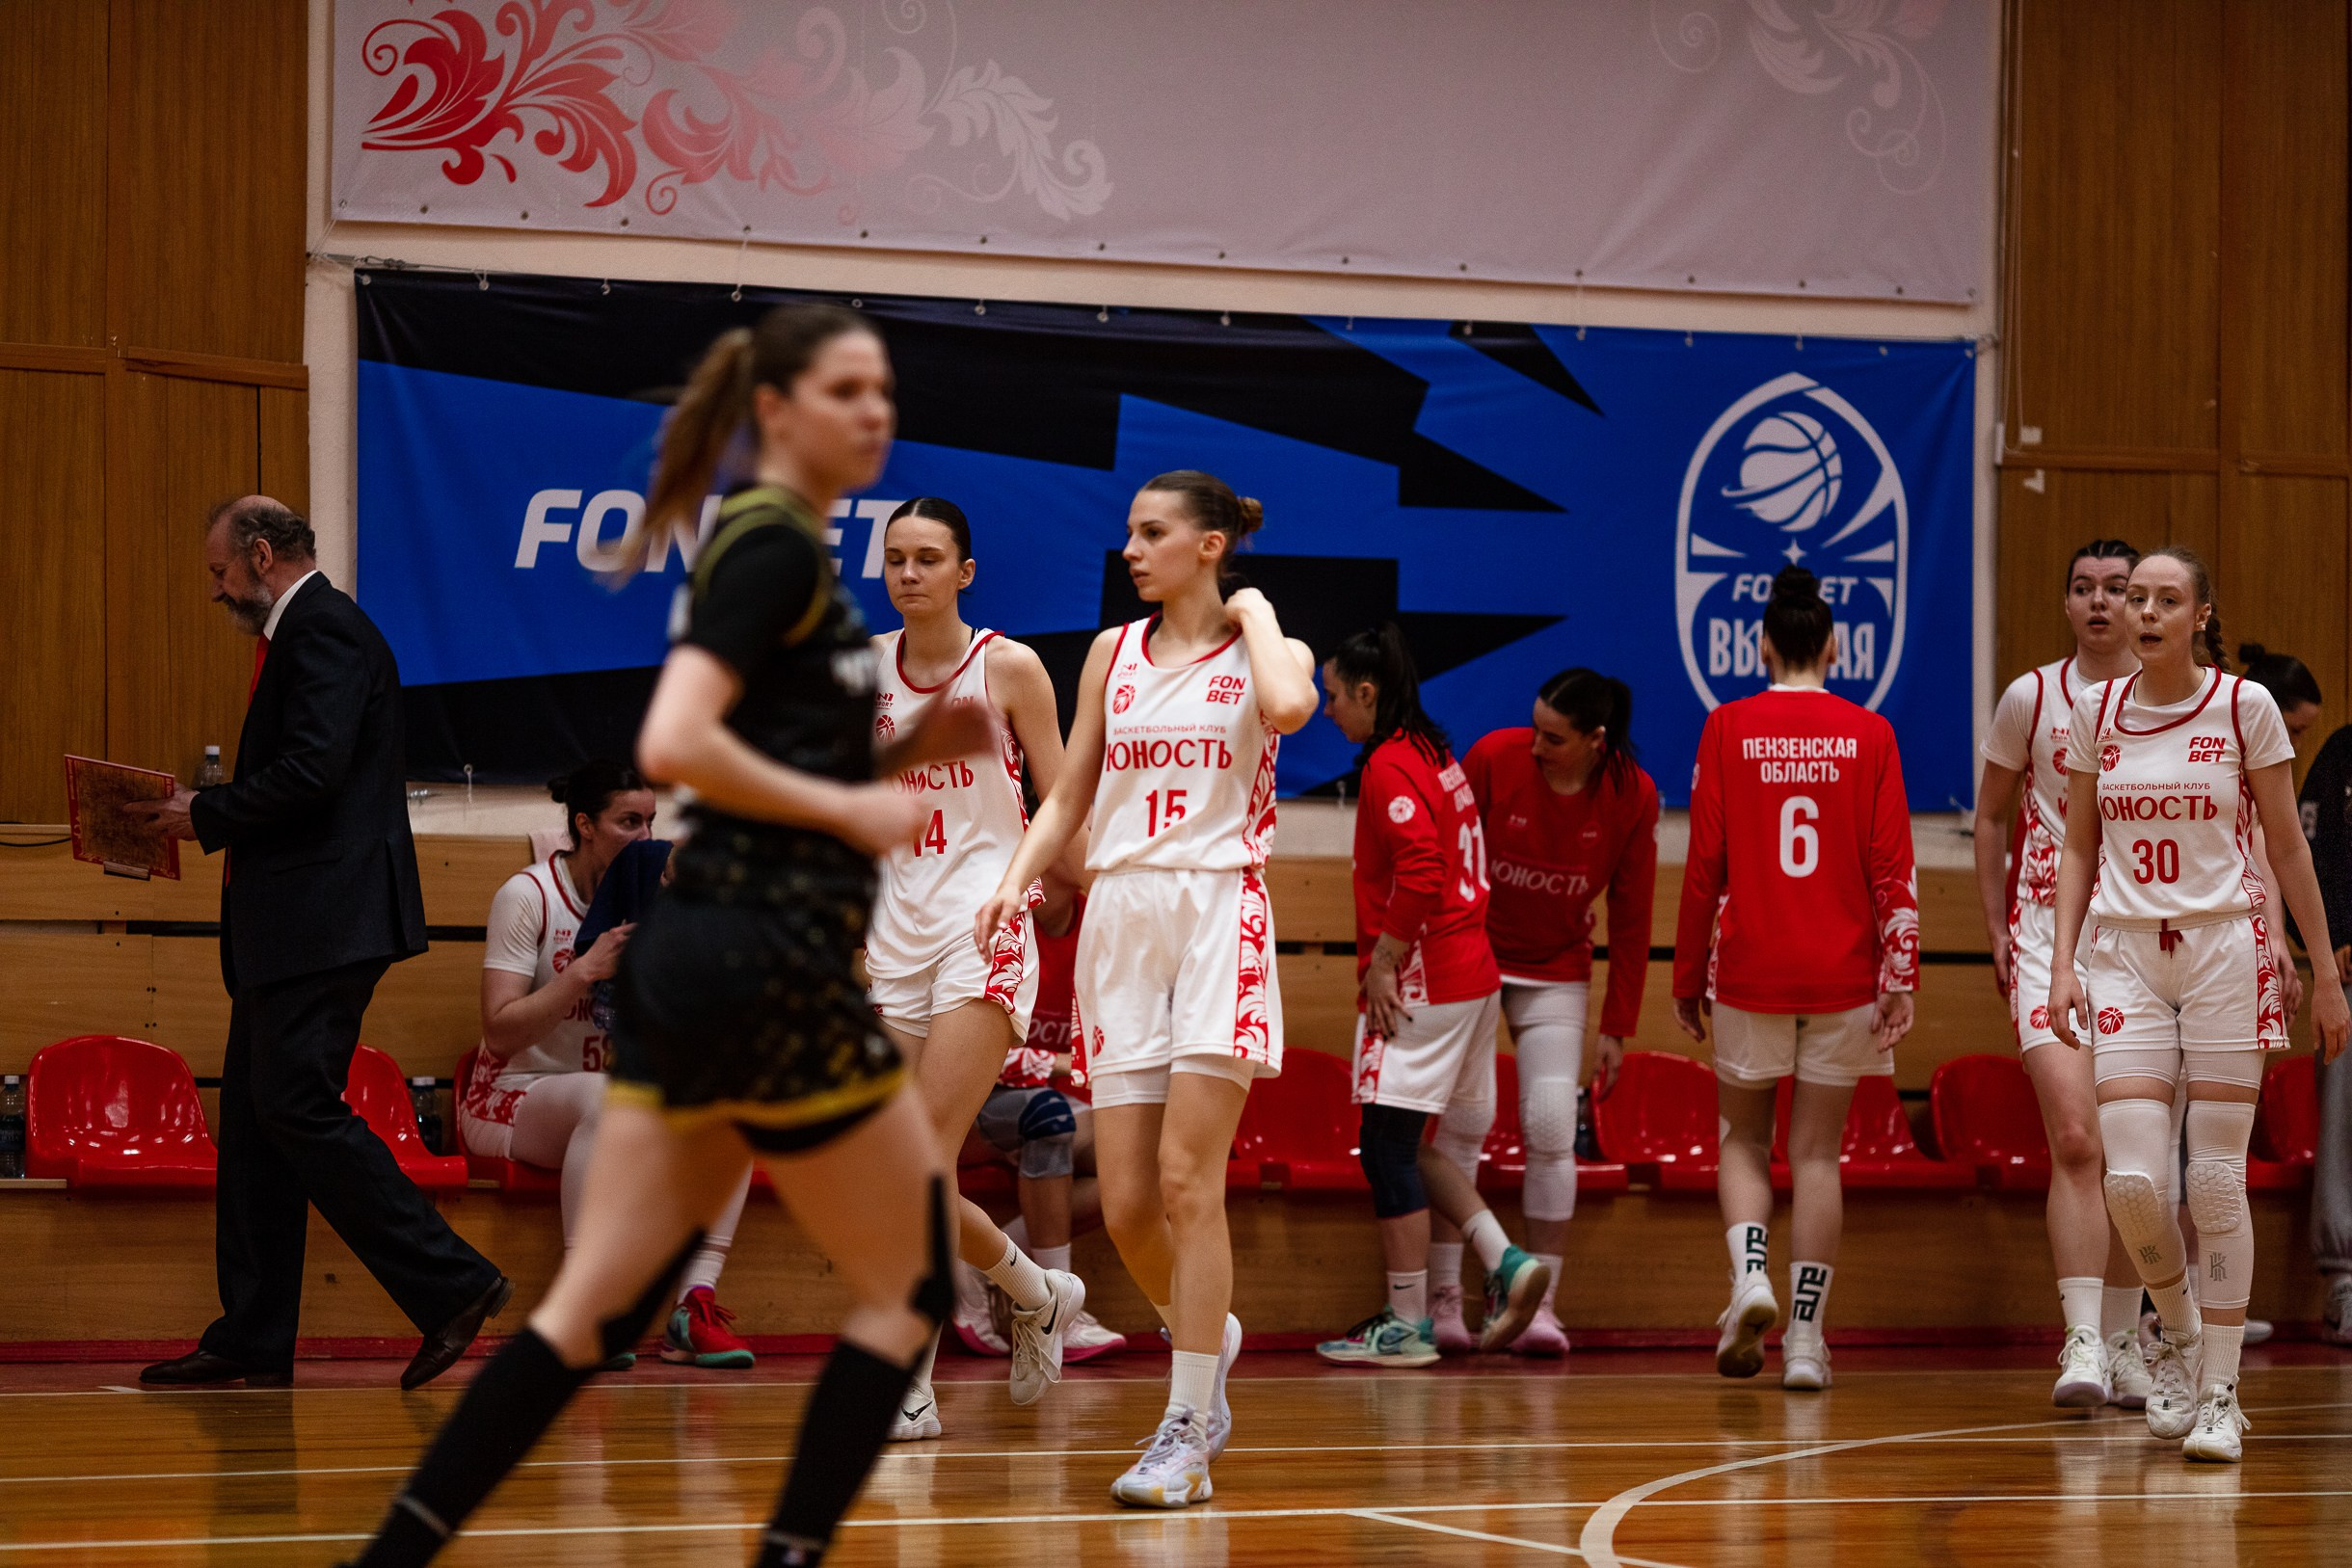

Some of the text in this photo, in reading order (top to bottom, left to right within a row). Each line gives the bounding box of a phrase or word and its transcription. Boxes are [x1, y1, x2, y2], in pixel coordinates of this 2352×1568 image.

[1732, 573, 1859, 605] FOET
[1708, 618, 1876, 680] ВЫАЯ
[1209, 676, 1246, 690] FON
[1206, 690, 1245, 705] BET
[1199, 724, 1227, 734] КЛУБ
[1106, 738, 1233, 772] ЮНОСТЬ
[1742, 737, 1858, 759] ПЕНЗЕНСКАЯ
[2189, 736, 2227, 750] FON
[2188, 750, 2226, 762] BET
[1760, 761, 1840, 784] ОБЛАСТЬ
[2102, 781, 2211, 791] БАСКЕТБОЛЬНЫЙ КЛУБ
[1145, 789, 1188, 837] 15
[2098, 795, 2218, 821] ЮНОСТЬ
[1779, 795, 1819, 878] 6
[2132, 838, 2179, 885] 30
[1491, 860, 1590, 896] ЮНОСТЬ
